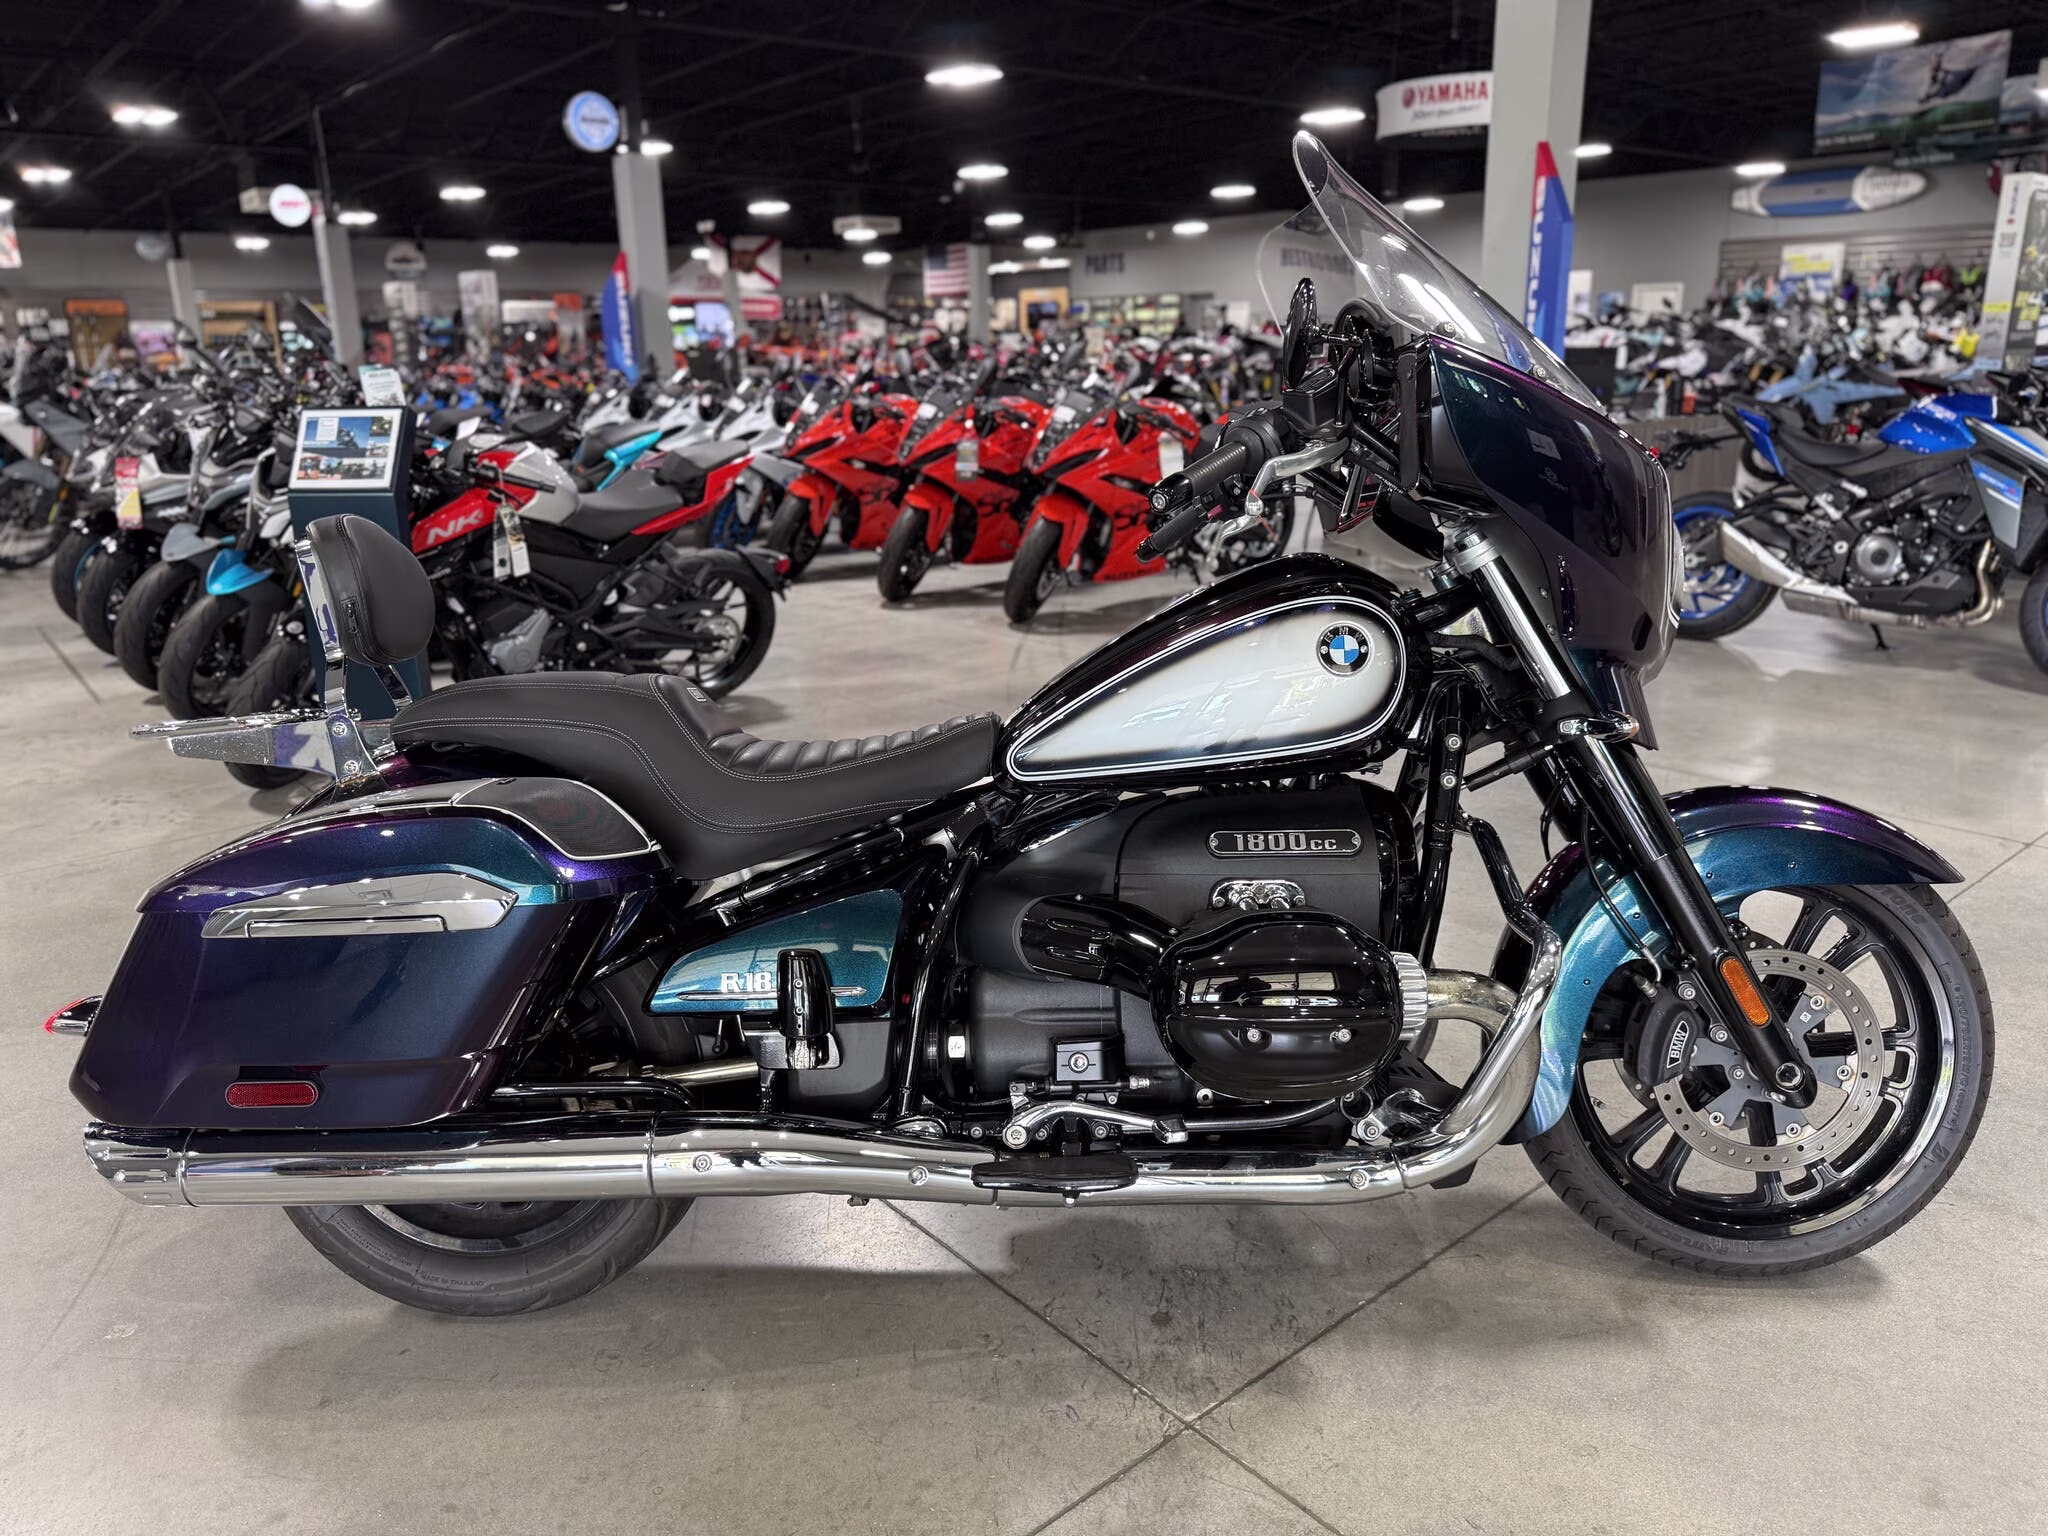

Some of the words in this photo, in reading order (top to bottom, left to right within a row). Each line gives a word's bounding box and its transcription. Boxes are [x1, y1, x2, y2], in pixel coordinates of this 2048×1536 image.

[1416, 80, 1488, 104] YAMAHA
[427, 508, 483, 545] NK
[1323, 626, 1365, 644] BMW
[1670, 1030, 1688, 1059] BMW
